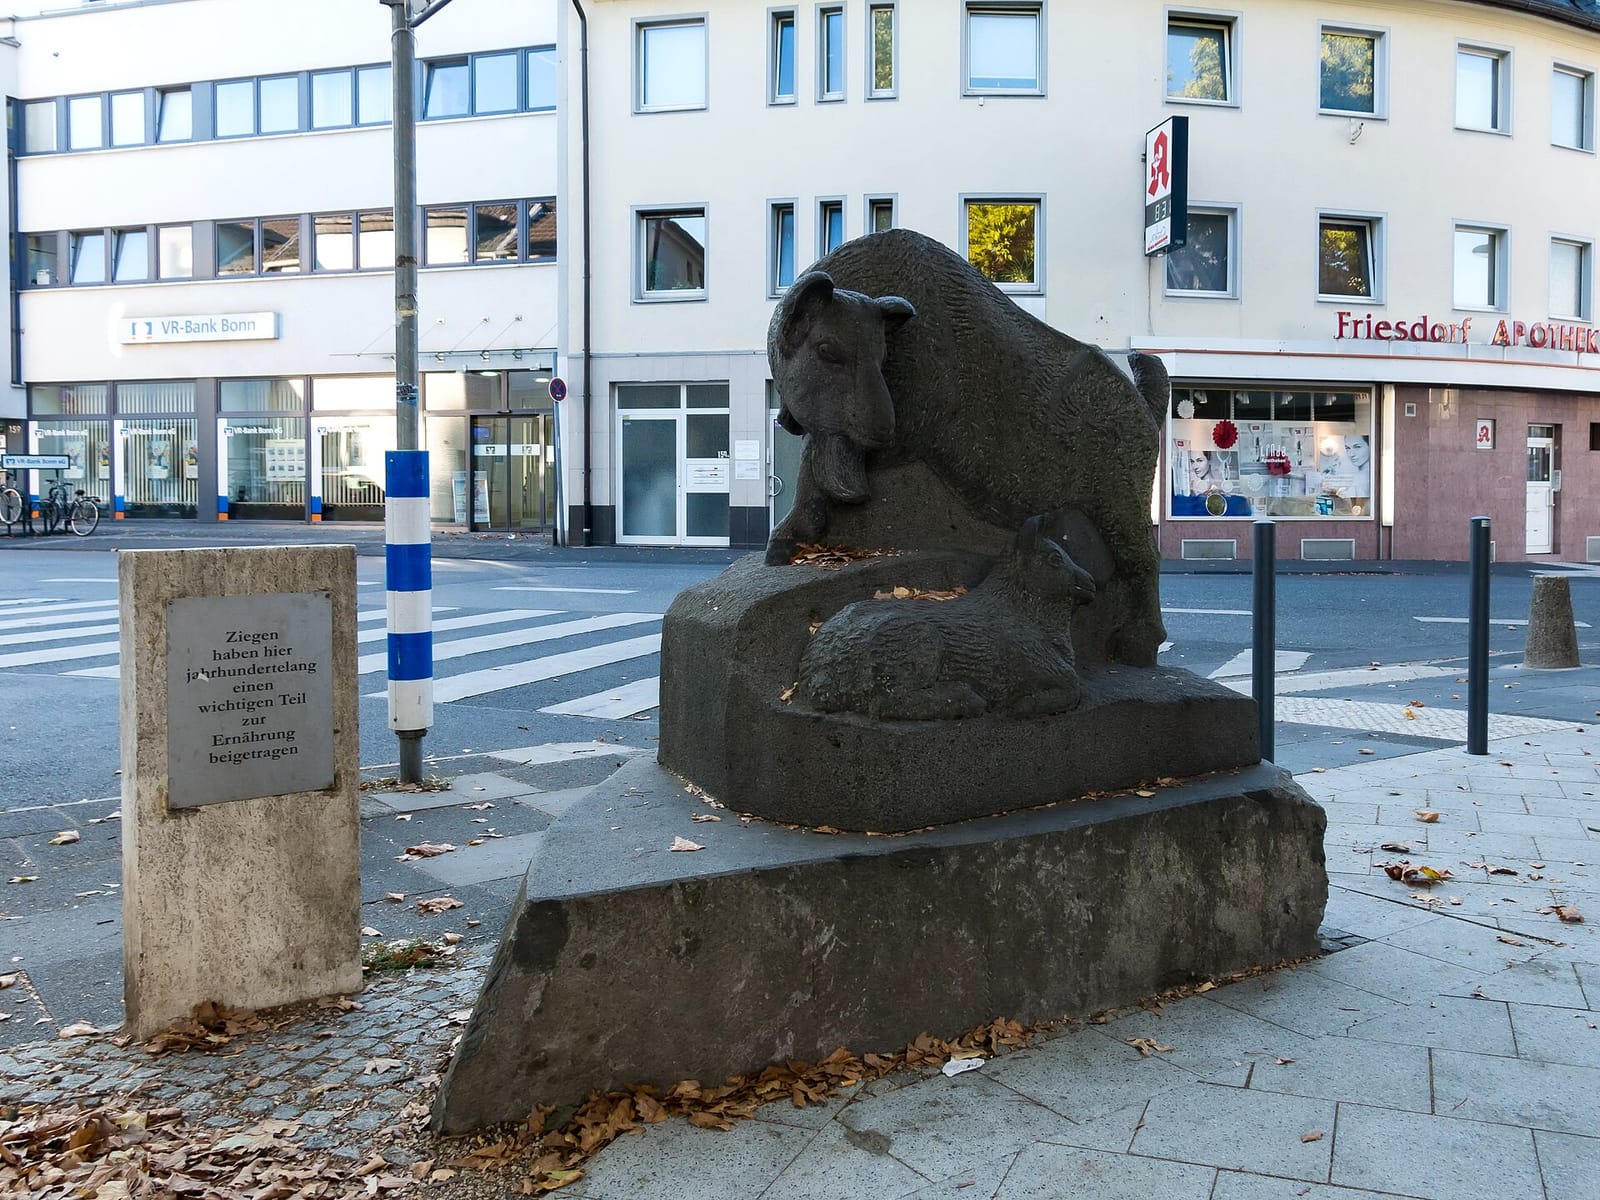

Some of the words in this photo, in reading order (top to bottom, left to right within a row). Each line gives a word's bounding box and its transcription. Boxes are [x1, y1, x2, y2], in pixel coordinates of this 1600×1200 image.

[161, 318, 217, 335] VR-Bank
[221, 318, 256, 332] Bonn
[1335, 311, 1472, 344] Friesdorf
[1491, 319, 1600, 353] APOTHEK
[226, 631, 279, 645] Ziegen
[212, 648, 259, 661] haben
[264, 646, 293, 658] hier
[186, 661, 317, 684] jahrhundertelang
[232, 681, 274, 693] einen
[198, 698, 274, 714] wichtigen
[278, 692, 307, 706] Teil
[241, 715, 267, 727] zur
[211, 729, 296, 747] Ernährung
[208, 744, 299, 766] beigetragen
